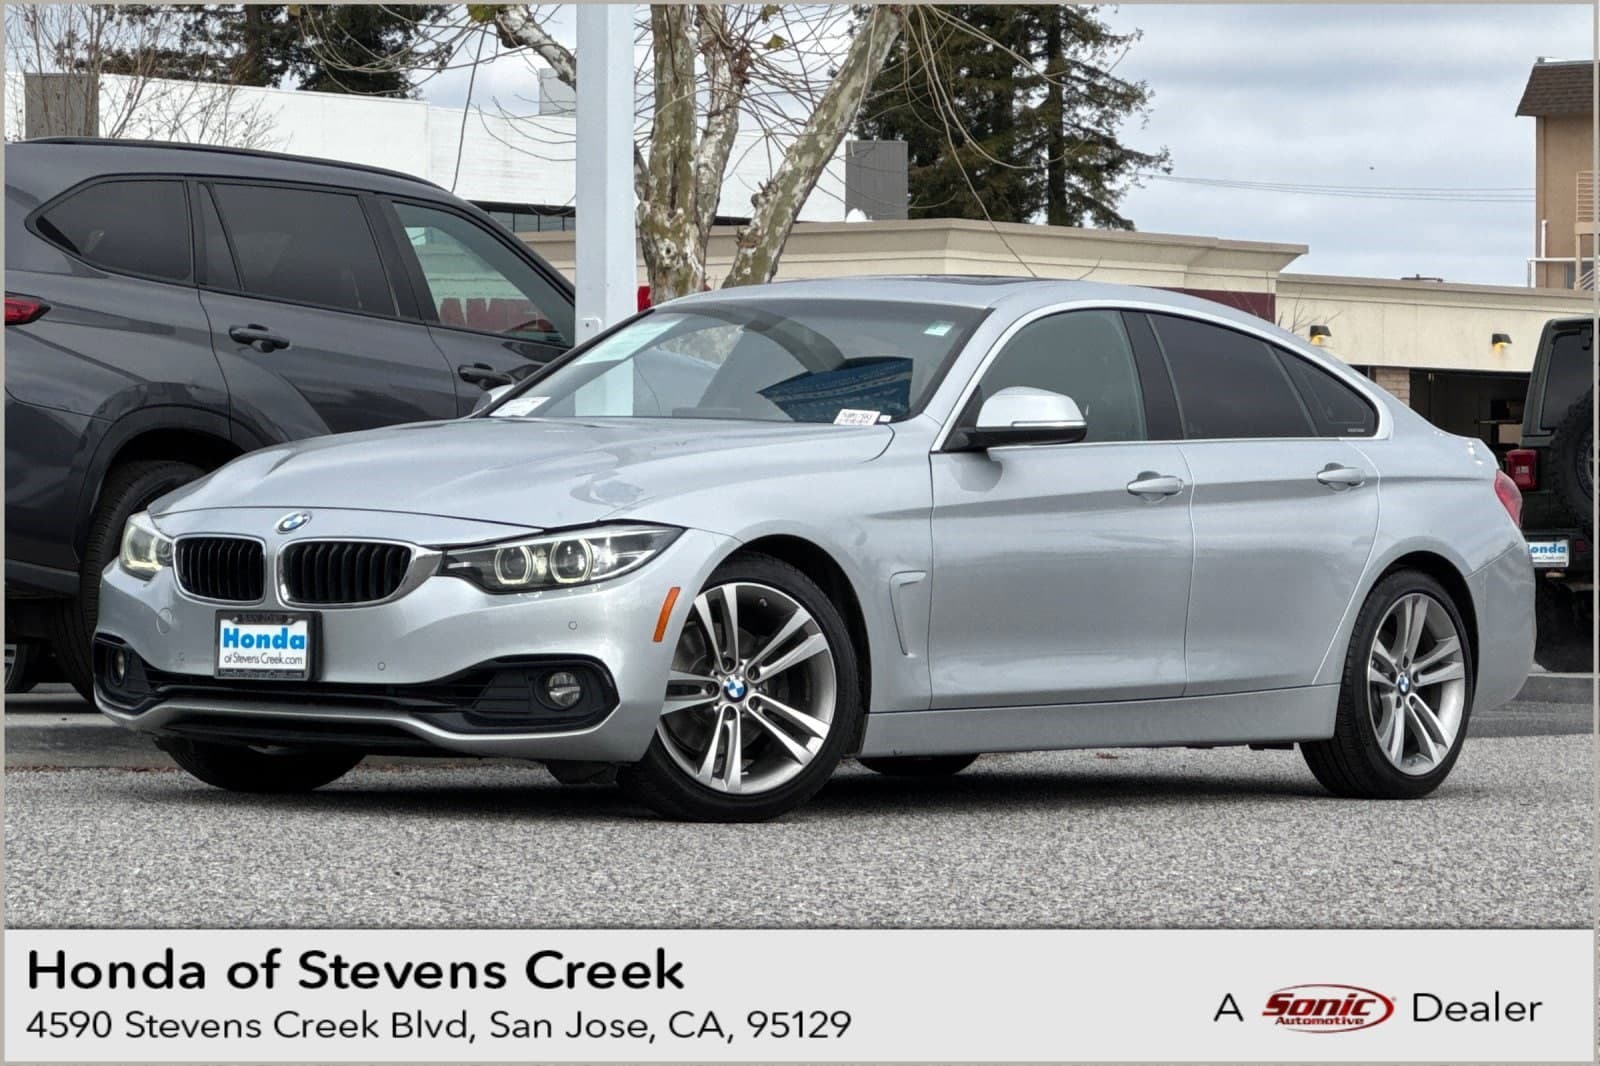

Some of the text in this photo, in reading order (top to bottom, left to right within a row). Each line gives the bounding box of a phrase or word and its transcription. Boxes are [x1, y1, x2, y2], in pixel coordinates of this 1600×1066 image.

[223, 627, 305, 650] Honda
[224, 651, 303, 665] of Stevens Creek.com
